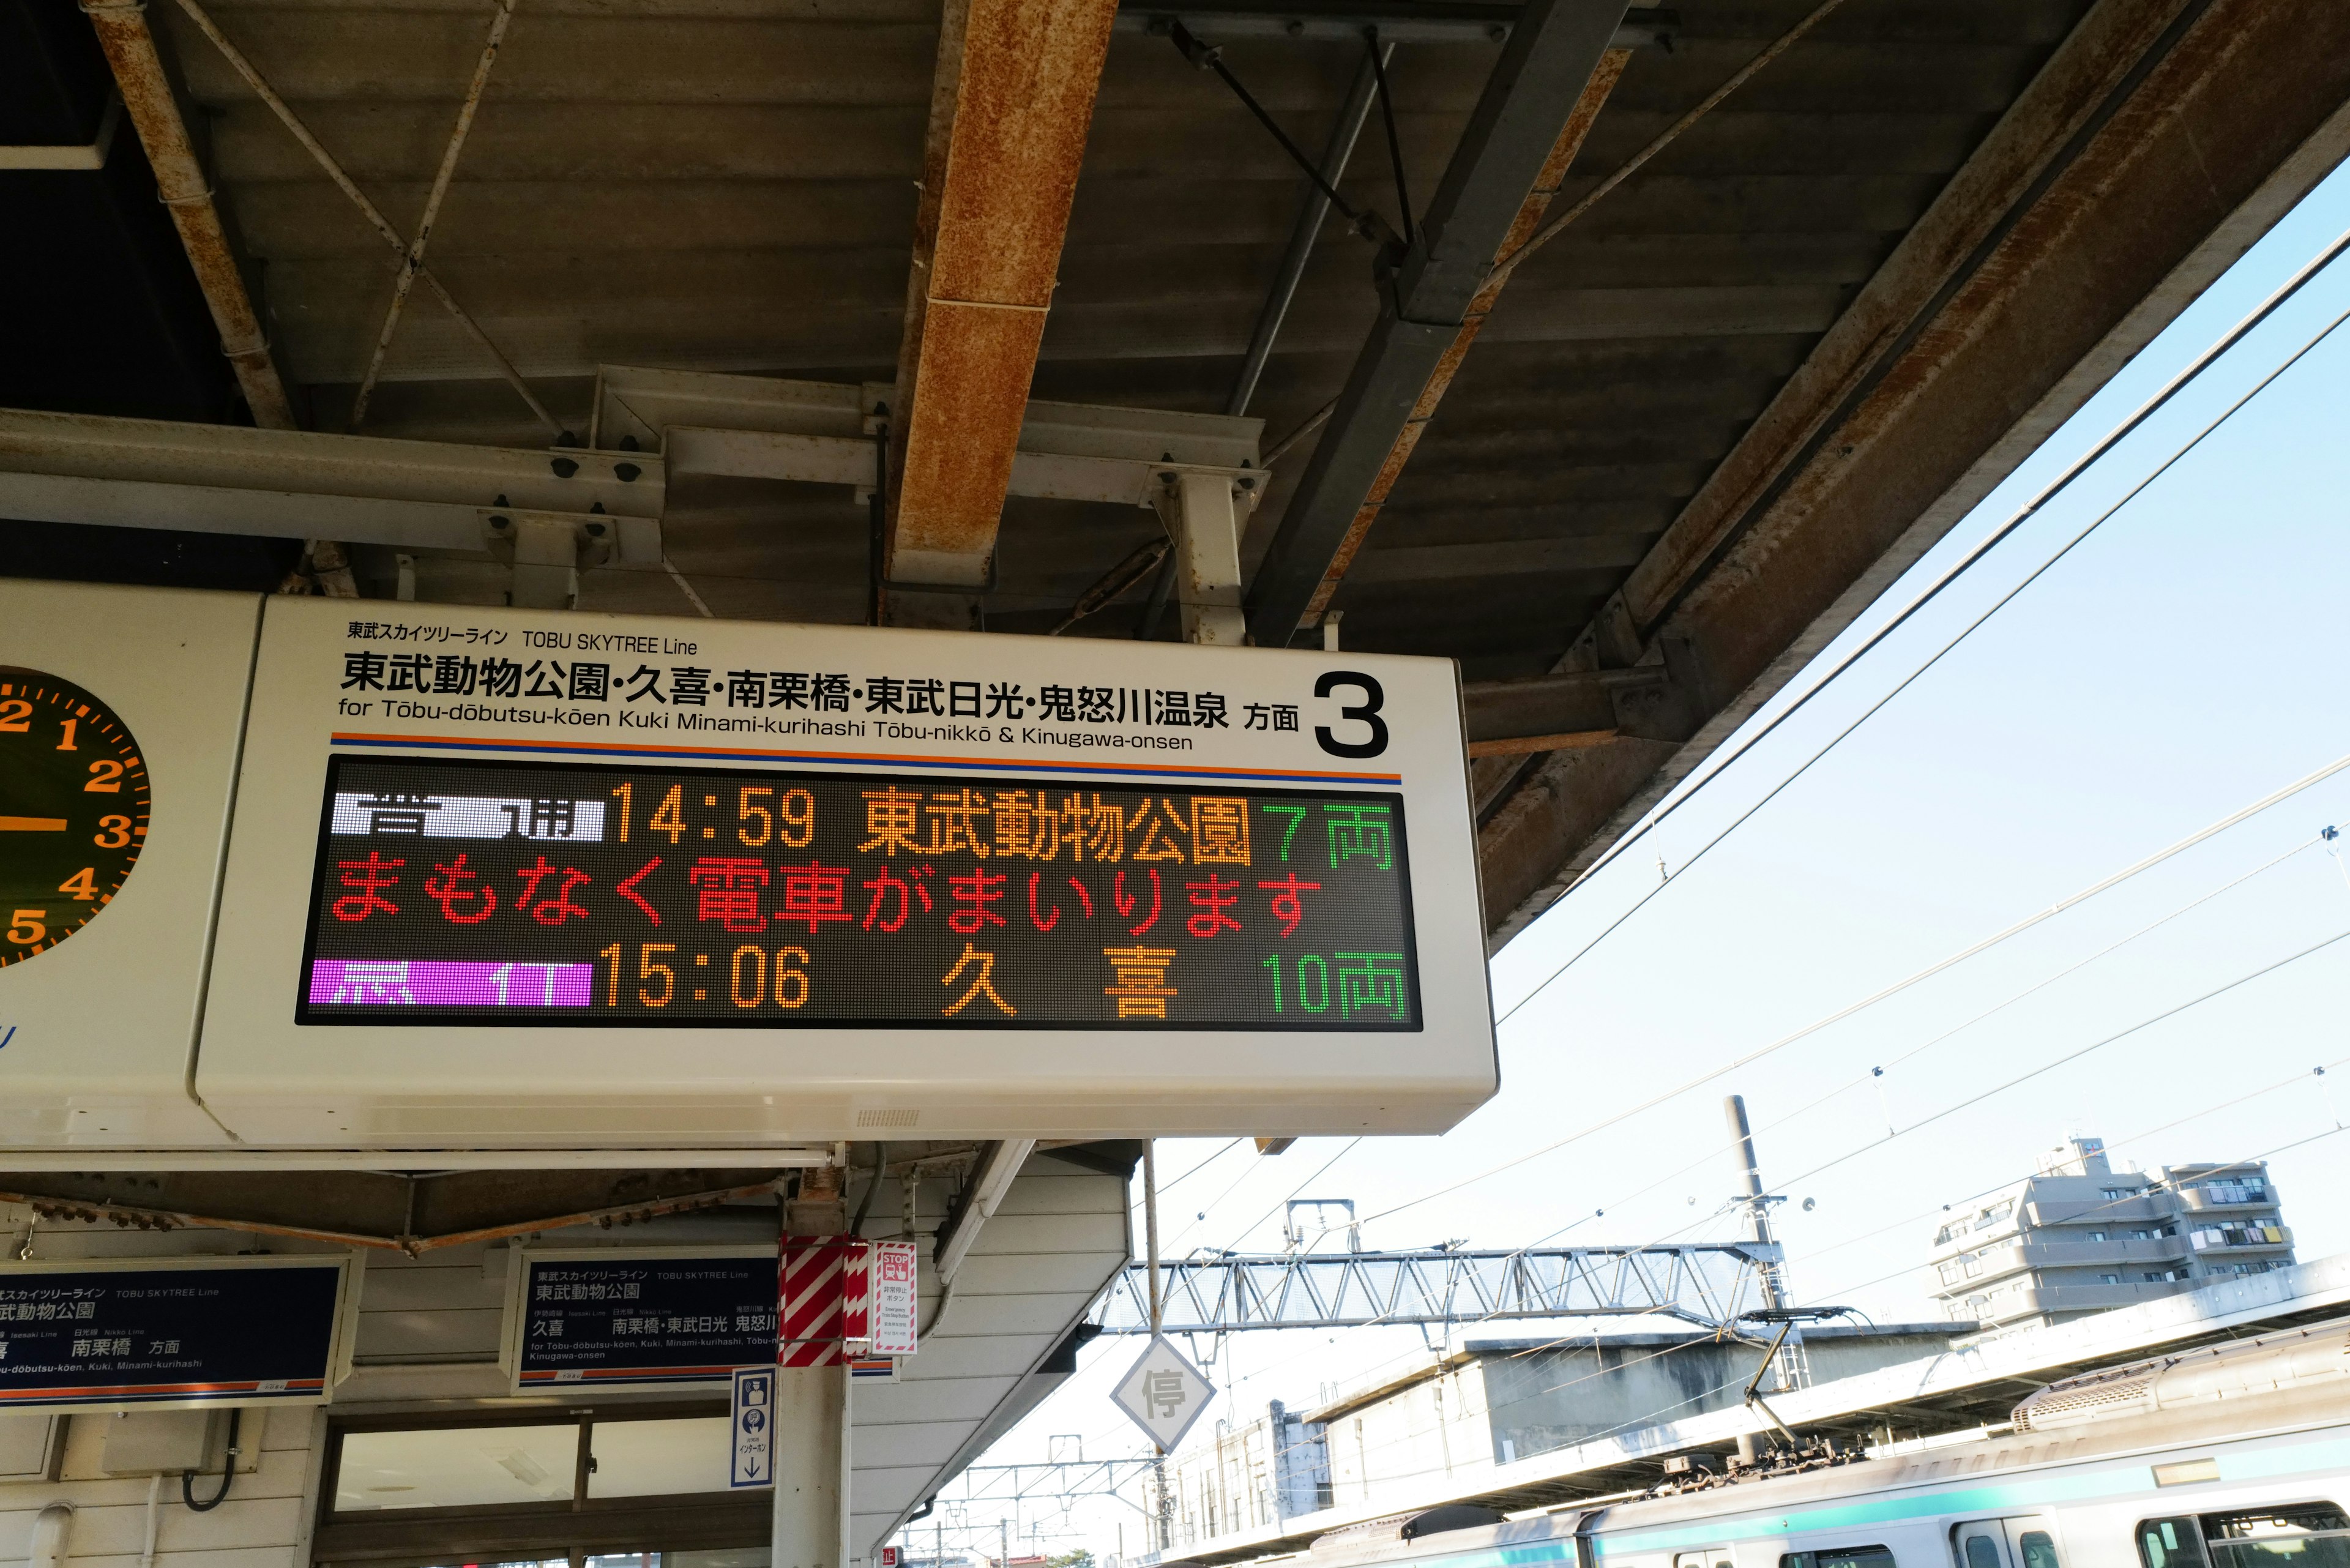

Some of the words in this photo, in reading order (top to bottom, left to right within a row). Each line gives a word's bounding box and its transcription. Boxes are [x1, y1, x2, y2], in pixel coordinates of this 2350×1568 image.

[348, 621, 507, 645] 東武スカイツリーライン
[523, 631, 571, 649] TOBU
[578, 633, 658, 654] SKYTREE
[664, 638, 698, 655] Line
[338, 698, 373, 717] for
[384, 700, 610, 727] Tōbu-dōbutsu-kōen
[619, 710, 669, 730] Kuki
[677, 713, 865, 737] Minami-kurihashi
[873, 720, 991, 742] Tōbu-nikkō
[999, 727, 1014, 742] &
[1023, 728, 1193, 750] Kinugawa-onsen
[1243, 703, 1299, 733] 方面
[1314, 671, 1389, 759] 3
[56, 719, 78, 750] 1
[84, 760, 124, 793] 2
[94, 815, 130, 848] 3
[612, 782, 815, 847] 14:59
[857, 786, 1251, 866] 東武動物公園
[58, 867, 99, 900] 4
[332, 852, 1321, 938] まもなく電車がまいります
[7, 909, 47, 944] 5
[600, 943, 810, 1009] 15:06
[884, 1254, 908, 1264] STOP
[537, 1271, 648, 1282] 東武スカイツリーライン
[116, 1290, 144, 1298] TOBU
[147, 1289, 195, 1297] SKYTREE
[199, 1288, 219, 1297] Line
[535, 1283, 640, 1301] 東武動物公園
[532, 1320, 564, 1337] 久喜
[72, 1338, 132, 1357] 南栗橋
[149, 1340, 180, 1354] 方面
[529, 1353, 605, 1362] Kinugawa-onsen
[117, 1359, 202, 1370] Minami-kurihashi
[1141, 1368, 1185, 1419] 停
[739, 1443, 766, 1454] インターホン
[883, 1550, 893, 1562] 止
